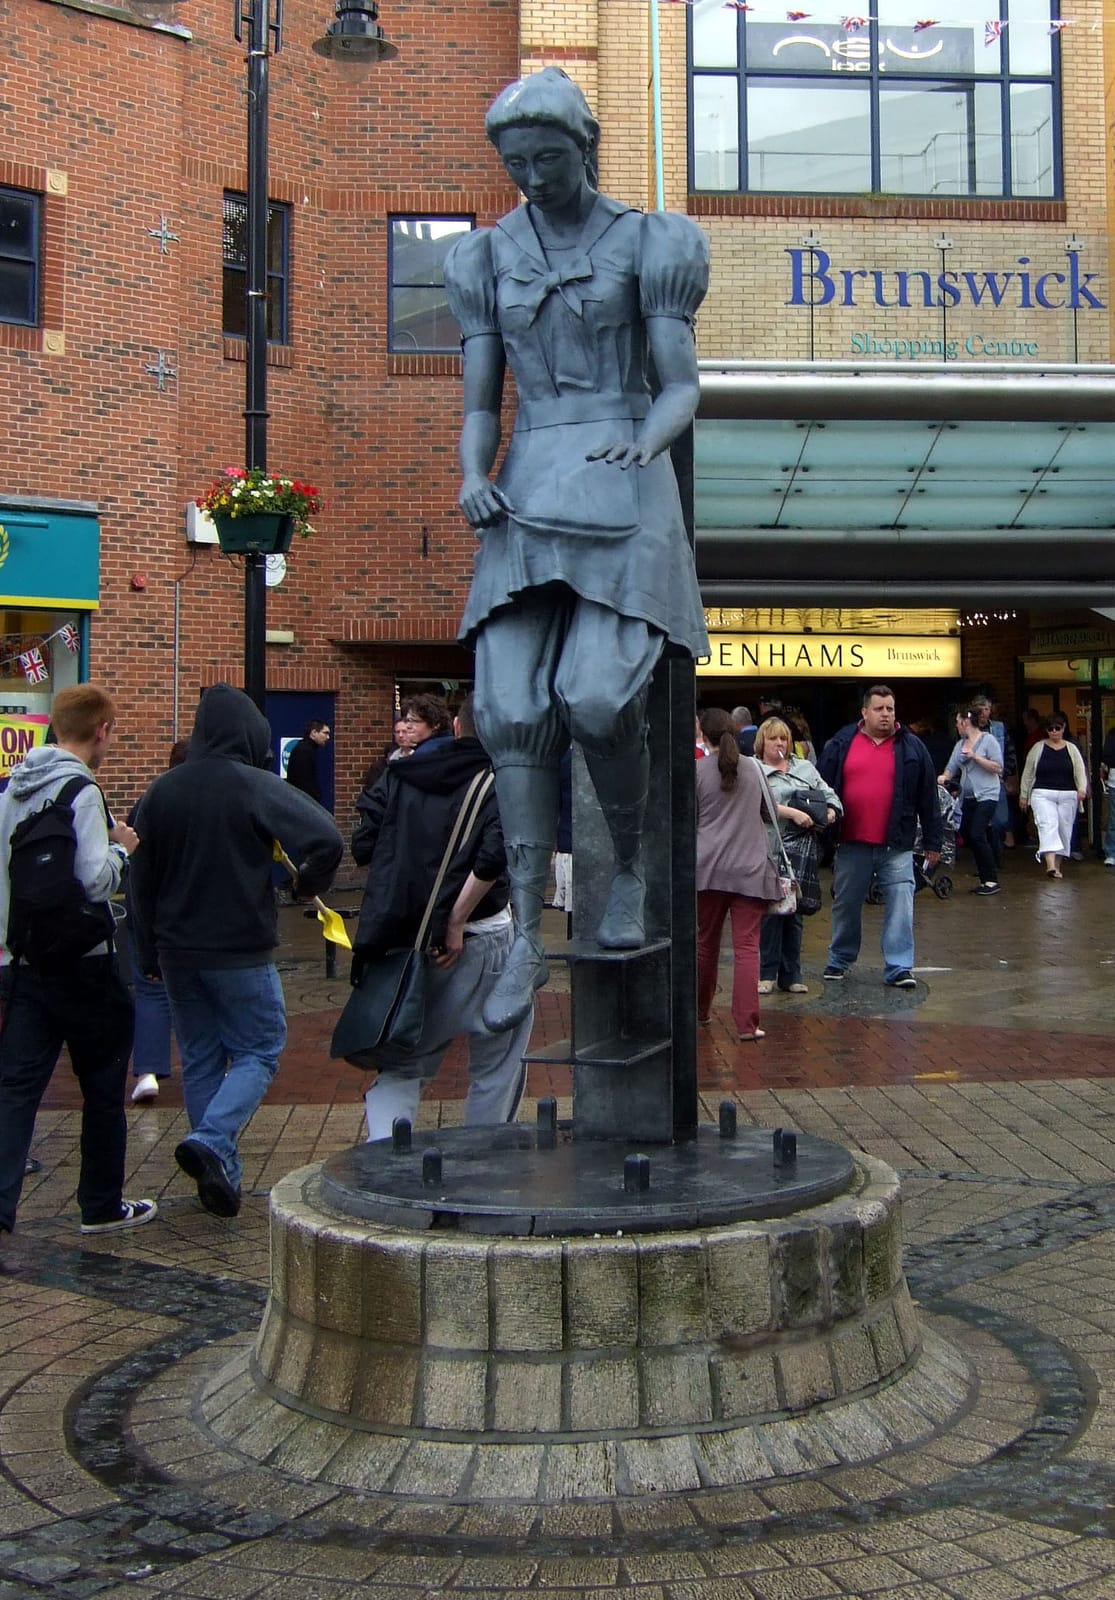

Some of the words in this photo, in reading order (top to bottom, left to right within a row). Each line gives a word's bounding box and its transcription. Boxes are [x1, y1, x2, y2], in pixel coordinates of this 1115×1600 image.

[784, 248, 1107, 309] Brunswick
[851, 333, 959, 360] Shopping
[966, 335, 1040, 357] Centre
[888, 648, 941, 661] Brunswick
[1, 726, 34, 754] ON
[2, 754, 27, 768] LON
